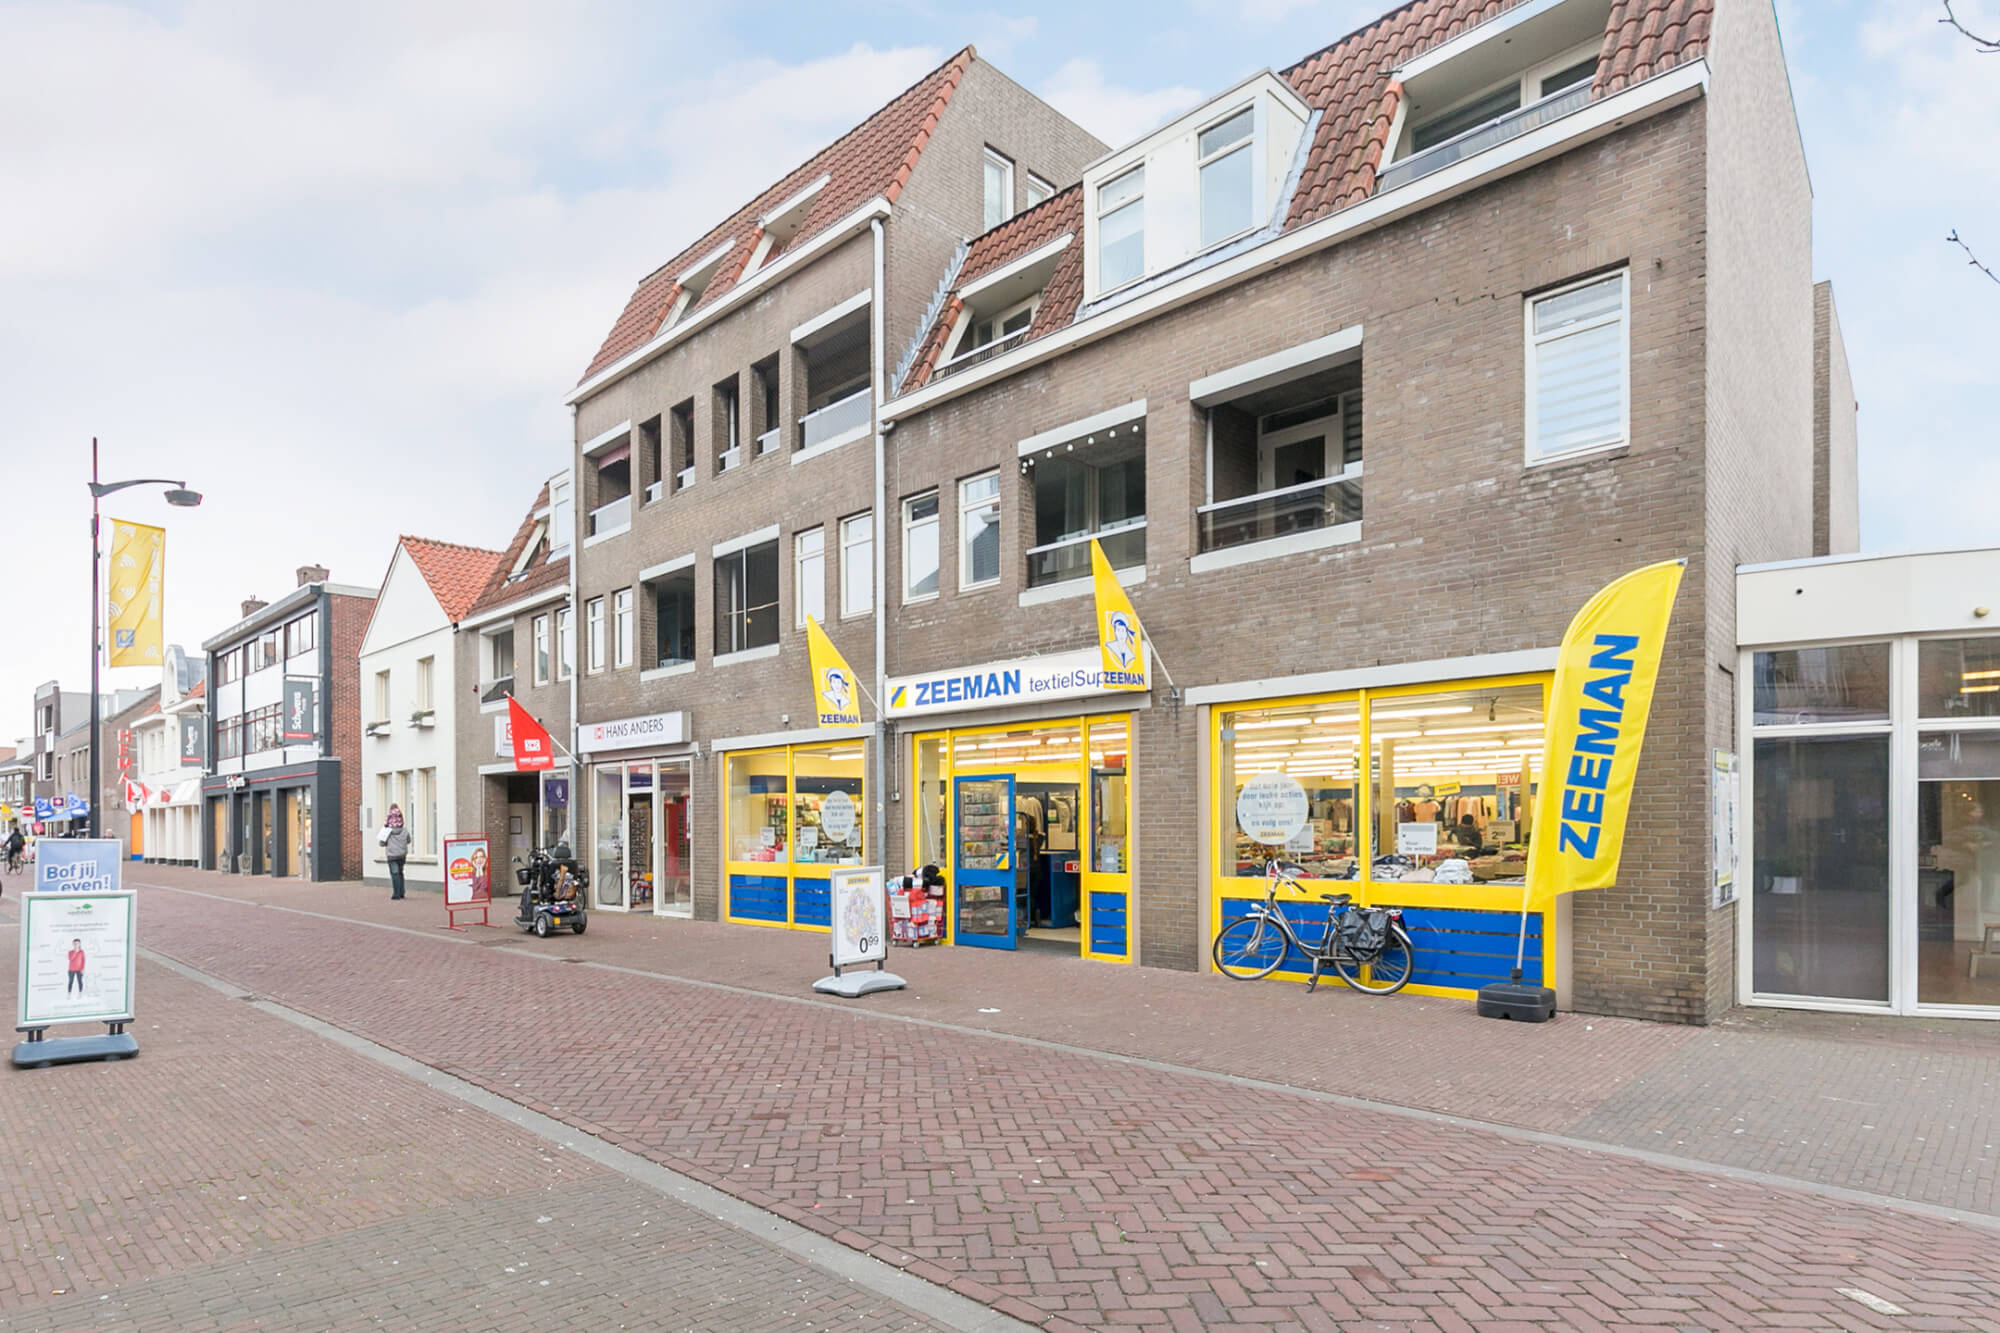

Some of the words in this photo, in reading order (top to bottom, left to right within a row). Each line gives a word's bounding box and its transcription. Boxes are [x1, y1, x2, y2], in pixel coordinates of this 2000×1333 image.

[1103, 671, 1145, 685] ZEEMAN
[915, 669, 1020, 706] ZEEMAN
[1029, 669, 1104, 692] textielSup
[606, 722, 629, 738] HANS
[630, 718, 664, 735] ANDERS
[820, 714, 859, 724] ZEEMAN
[1559, 634, 1640, 859] ZEEMAN
[118, 729, 131, 785] HEMA
[47, 864, 76, 879] Bof
[79, 862, 95, 879] jij
[61, 876, 108, 891] even!
